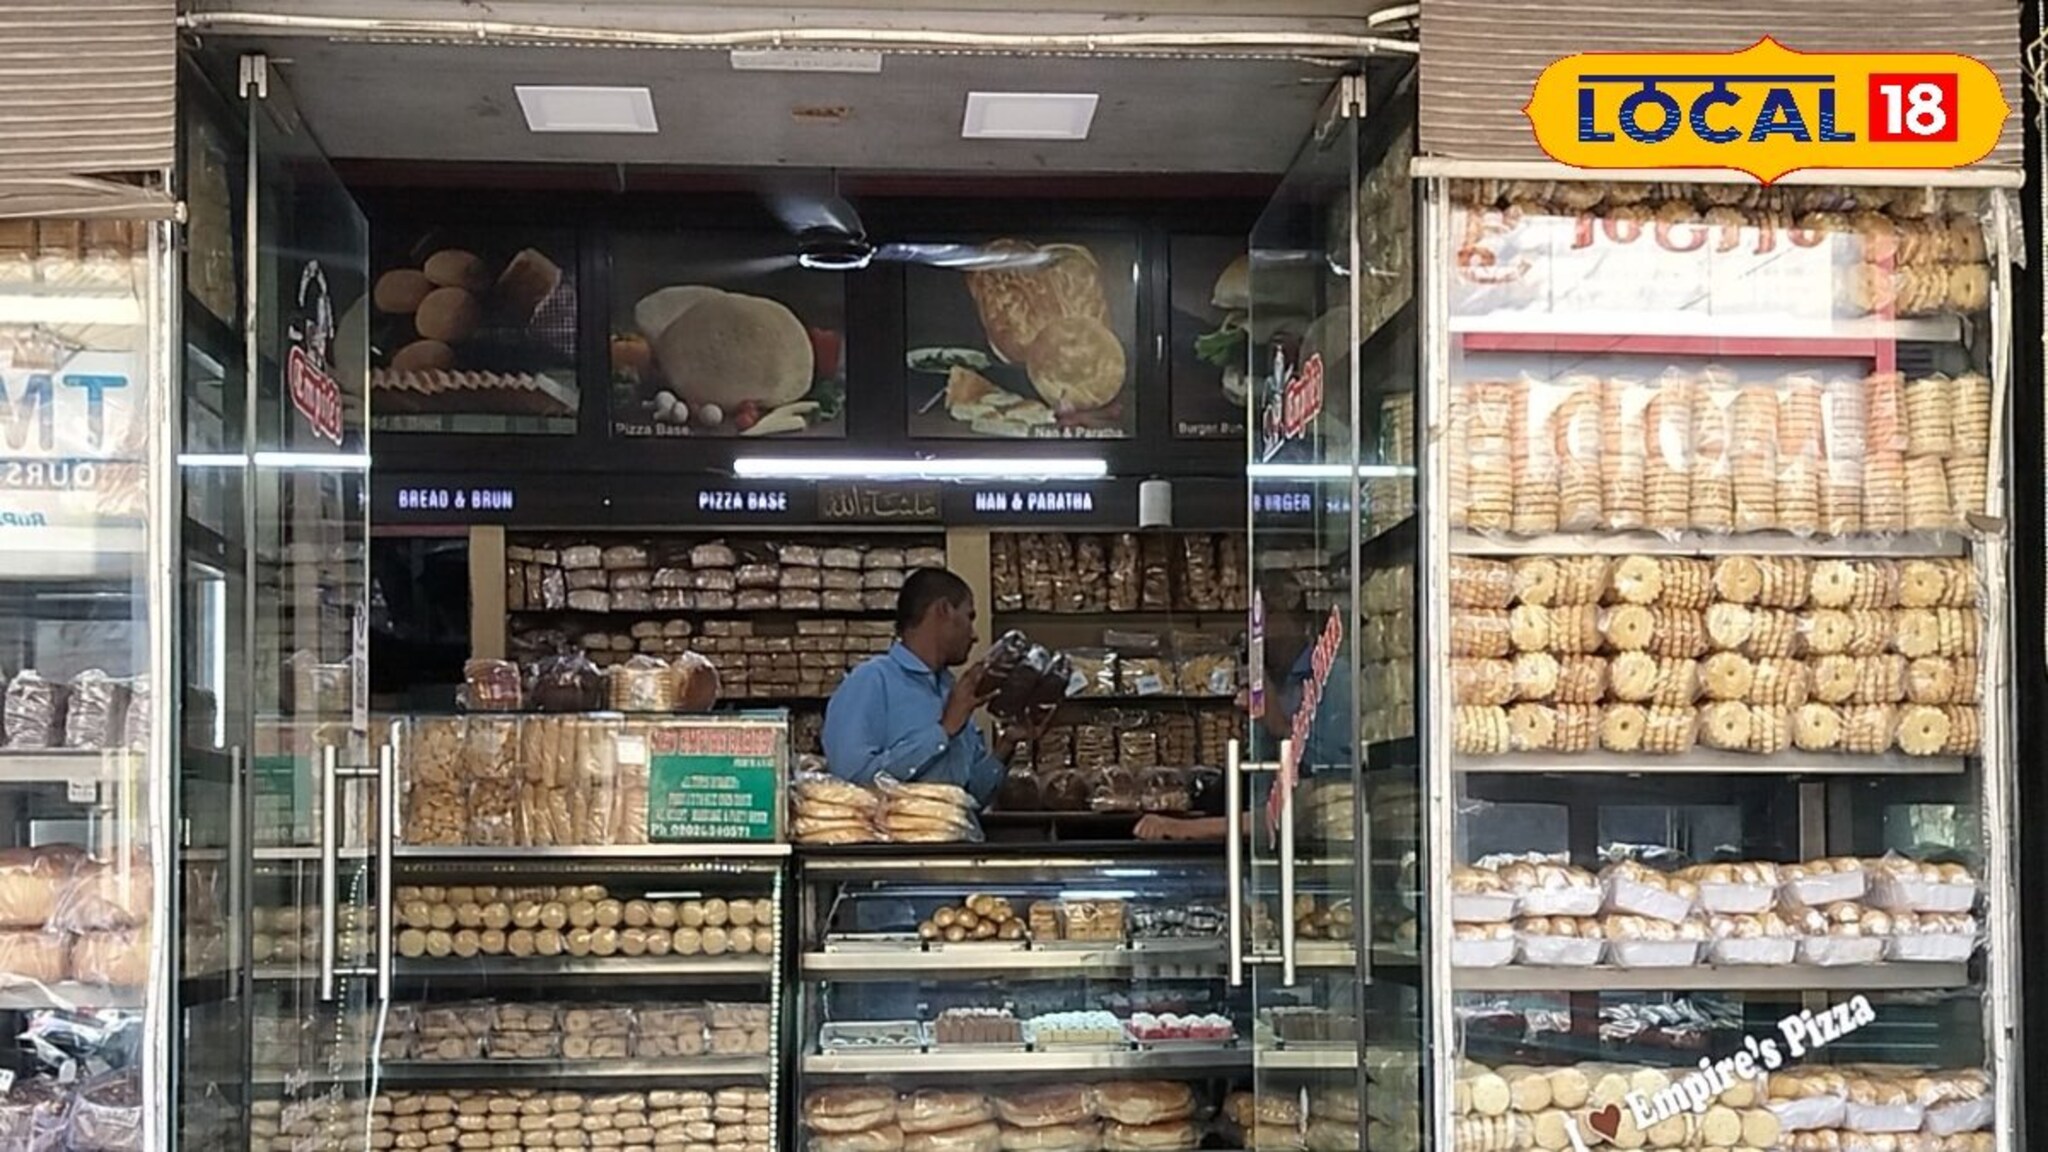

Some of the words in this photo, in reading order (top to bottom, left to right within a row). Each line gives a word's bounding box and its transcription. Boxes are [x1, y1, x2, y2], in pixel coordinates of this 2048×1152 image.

[615, 422, 652, 436] Pizza
[399, 489, 449, 508] BREAD
[454, 489, 466, 509] &
[471, 489, 513, 509] BRUN
[698, 492, 743, 511] PIZZA
[748, 492, 788, 511] BASE
[976, 492, 1007, 511] NAN
[1011, 492, 1023, 511] &
[1027, 492, 1093, 511] PARATHA
[1624, 1035, 1783, 1130] Empire's
[1777, 994, 1876, 1057] Pizza
